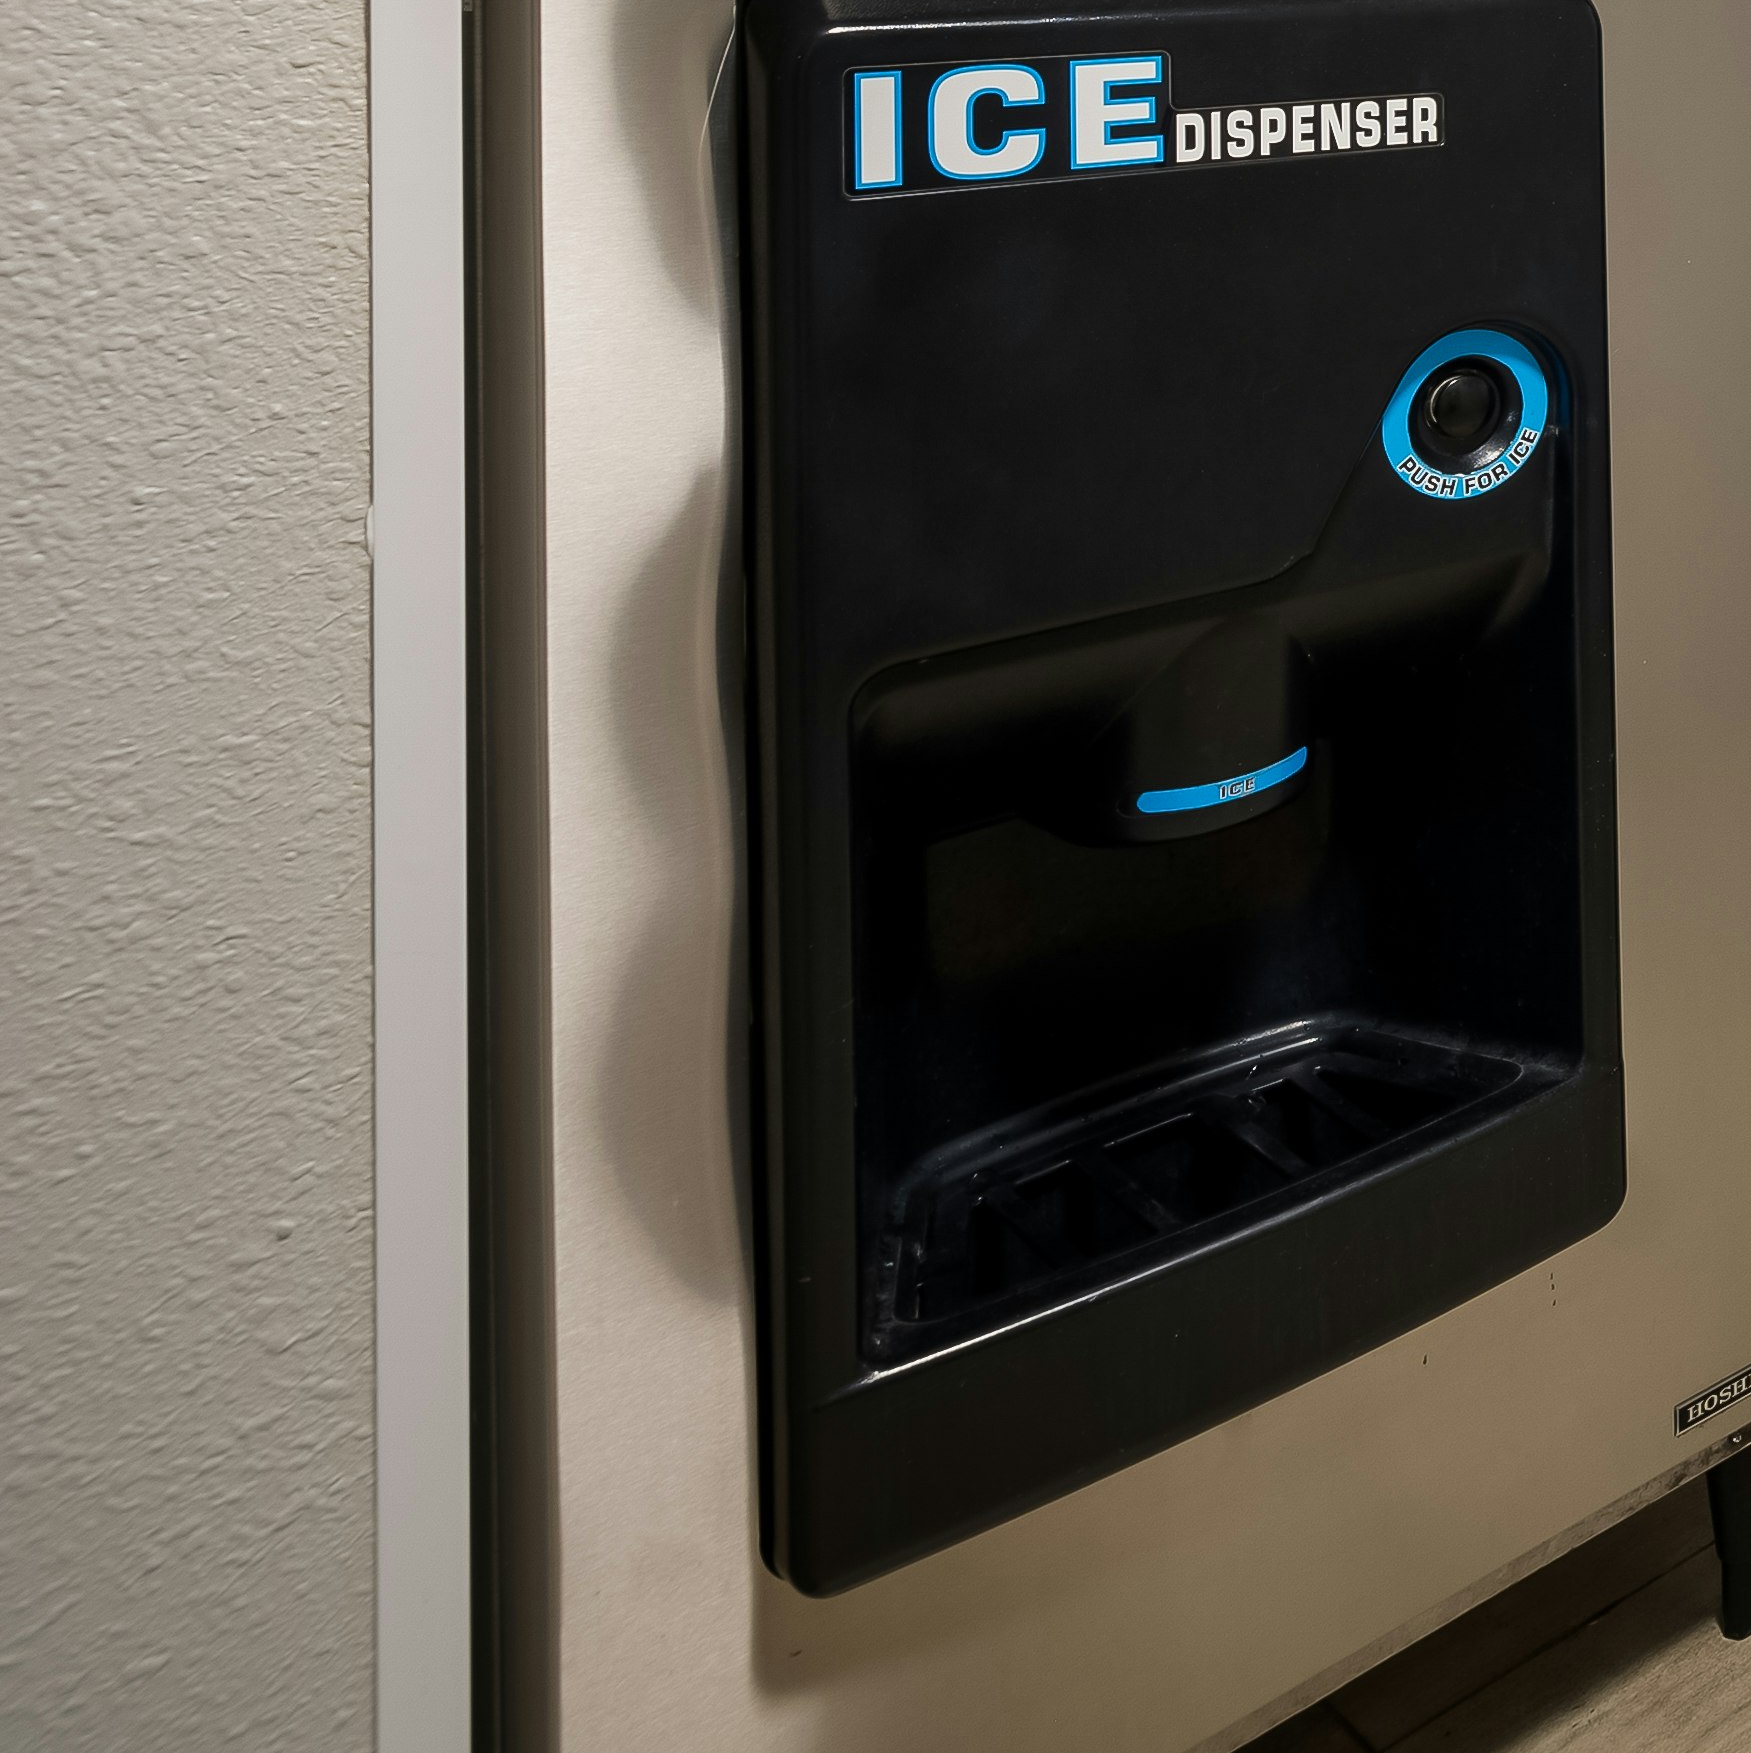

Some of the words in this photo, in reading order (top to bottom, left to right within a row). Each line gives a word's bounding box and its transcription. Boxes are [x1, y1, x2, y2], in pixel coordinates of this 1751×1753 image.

[854, 55, 1164, 190] ICE
[1175, 96, 1439, 163] DISPENSER
[1397, 454, 1458, 498] PUSH
[1463, 463, 1509, 497] FOR
[1507, 427, 1540, 466] ICE
[1219, 777, 1256, 799] ICE
